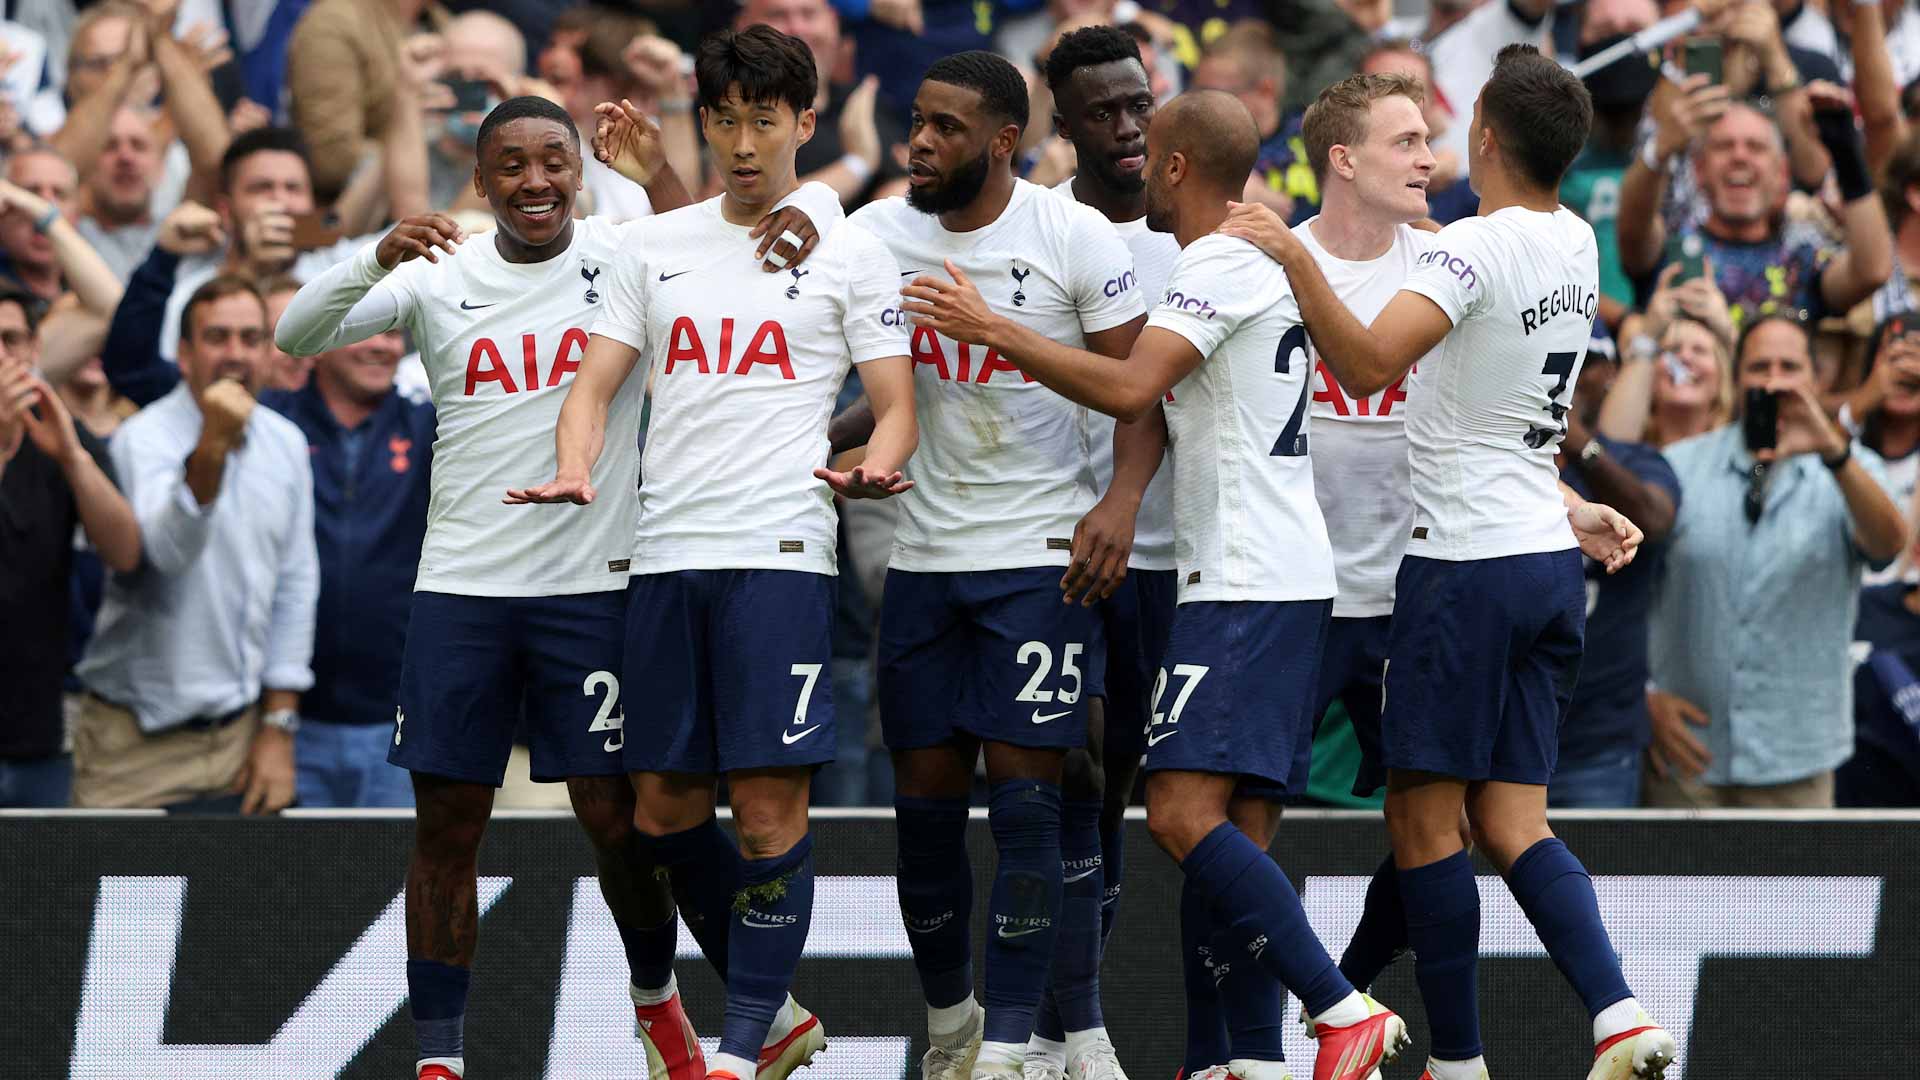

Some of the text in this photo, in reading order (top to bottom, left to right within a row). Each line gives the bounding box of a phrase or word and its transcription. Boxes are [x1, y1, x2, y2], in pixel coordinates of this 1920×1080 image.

[1103, 270, 1137, 298] cin
[664, 316, 796, 380] AIA
[583, 670, 624, 732] 2
[790, 663, 823, 725] 7
[1016, 641, 1085, 704] 25
[1147, 663, 1210, 727] 27
[1061, 854, 1102, 870] PURS
[748, 908, 798, 924] PURS
